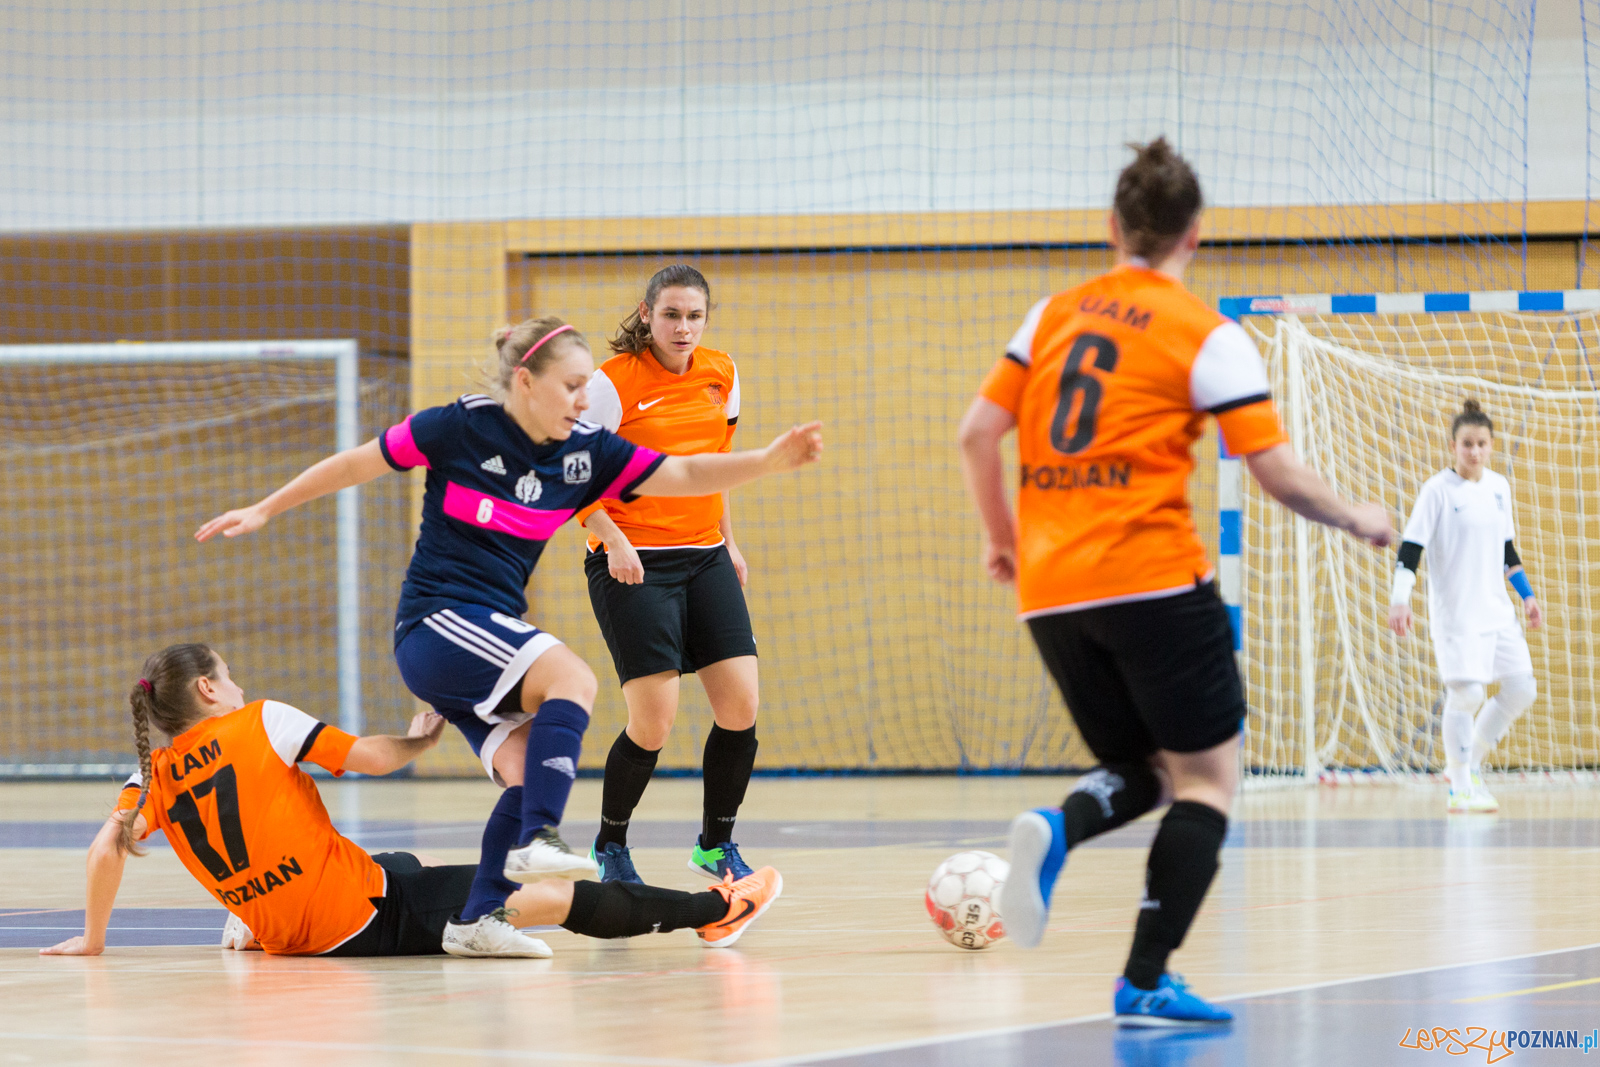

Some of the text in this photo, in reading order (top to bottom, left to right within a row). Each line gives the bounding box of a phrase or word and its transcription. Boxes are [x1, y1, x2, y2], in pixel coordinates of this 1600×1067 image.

[1079, 295, 1152, 330] UAM
[1050, 332, 1119, 454] 6
[476, 498, 494, 523] 6
[167, 763, 250, 882] 17
